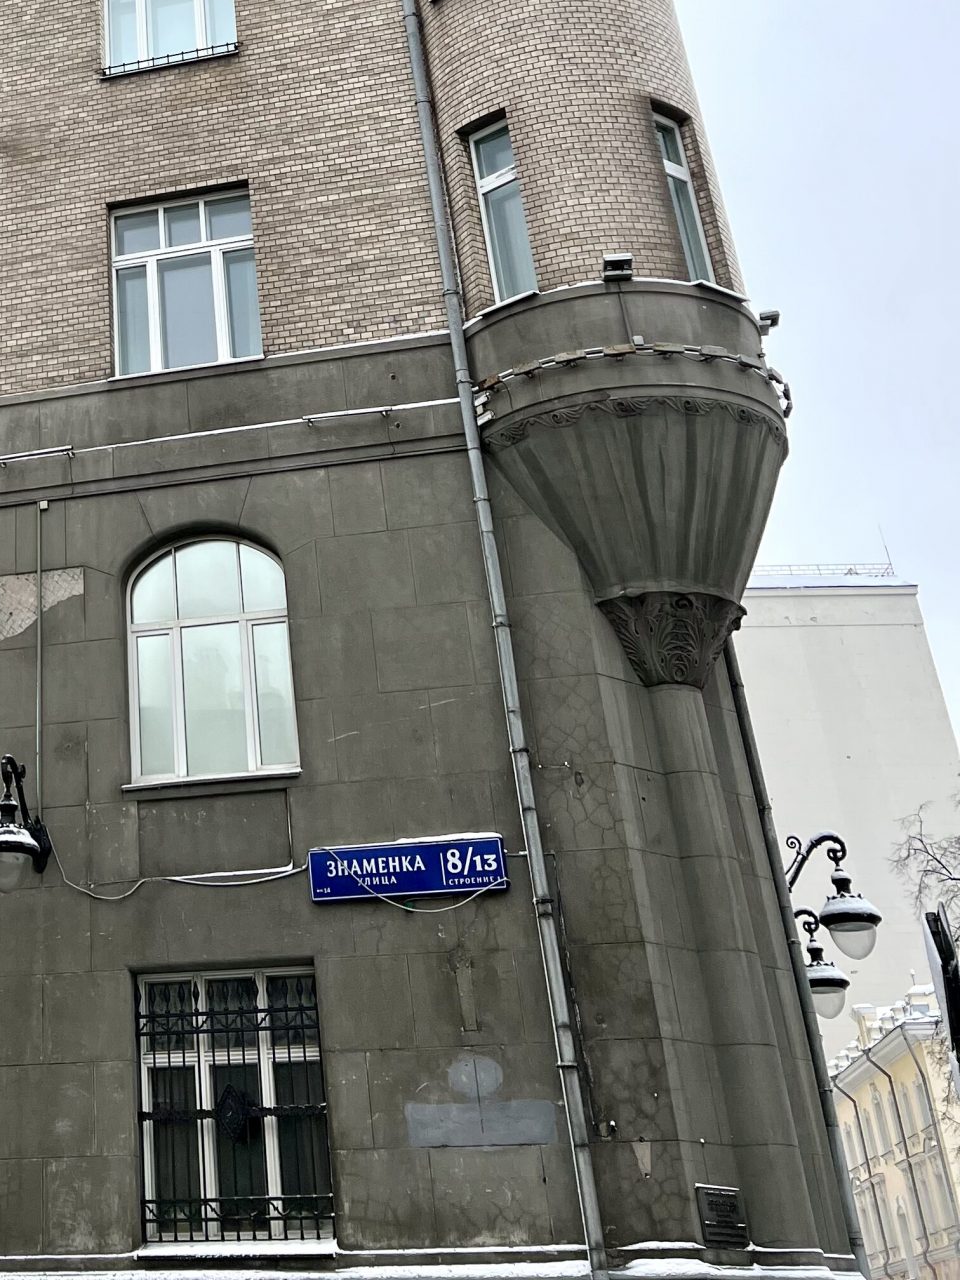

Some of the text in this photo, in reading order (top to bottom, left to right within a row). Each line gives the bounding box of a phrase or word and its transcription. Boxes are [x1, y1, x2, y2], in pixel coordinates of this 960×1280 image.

[327, 855, 426, 877] ЗНАМЕНКА
[446, 847, 497, 875] 8/13
[358, 875, 397, 886] УЛИЦА
[449, 876, 494, 885] СТРОЕНИЕ
